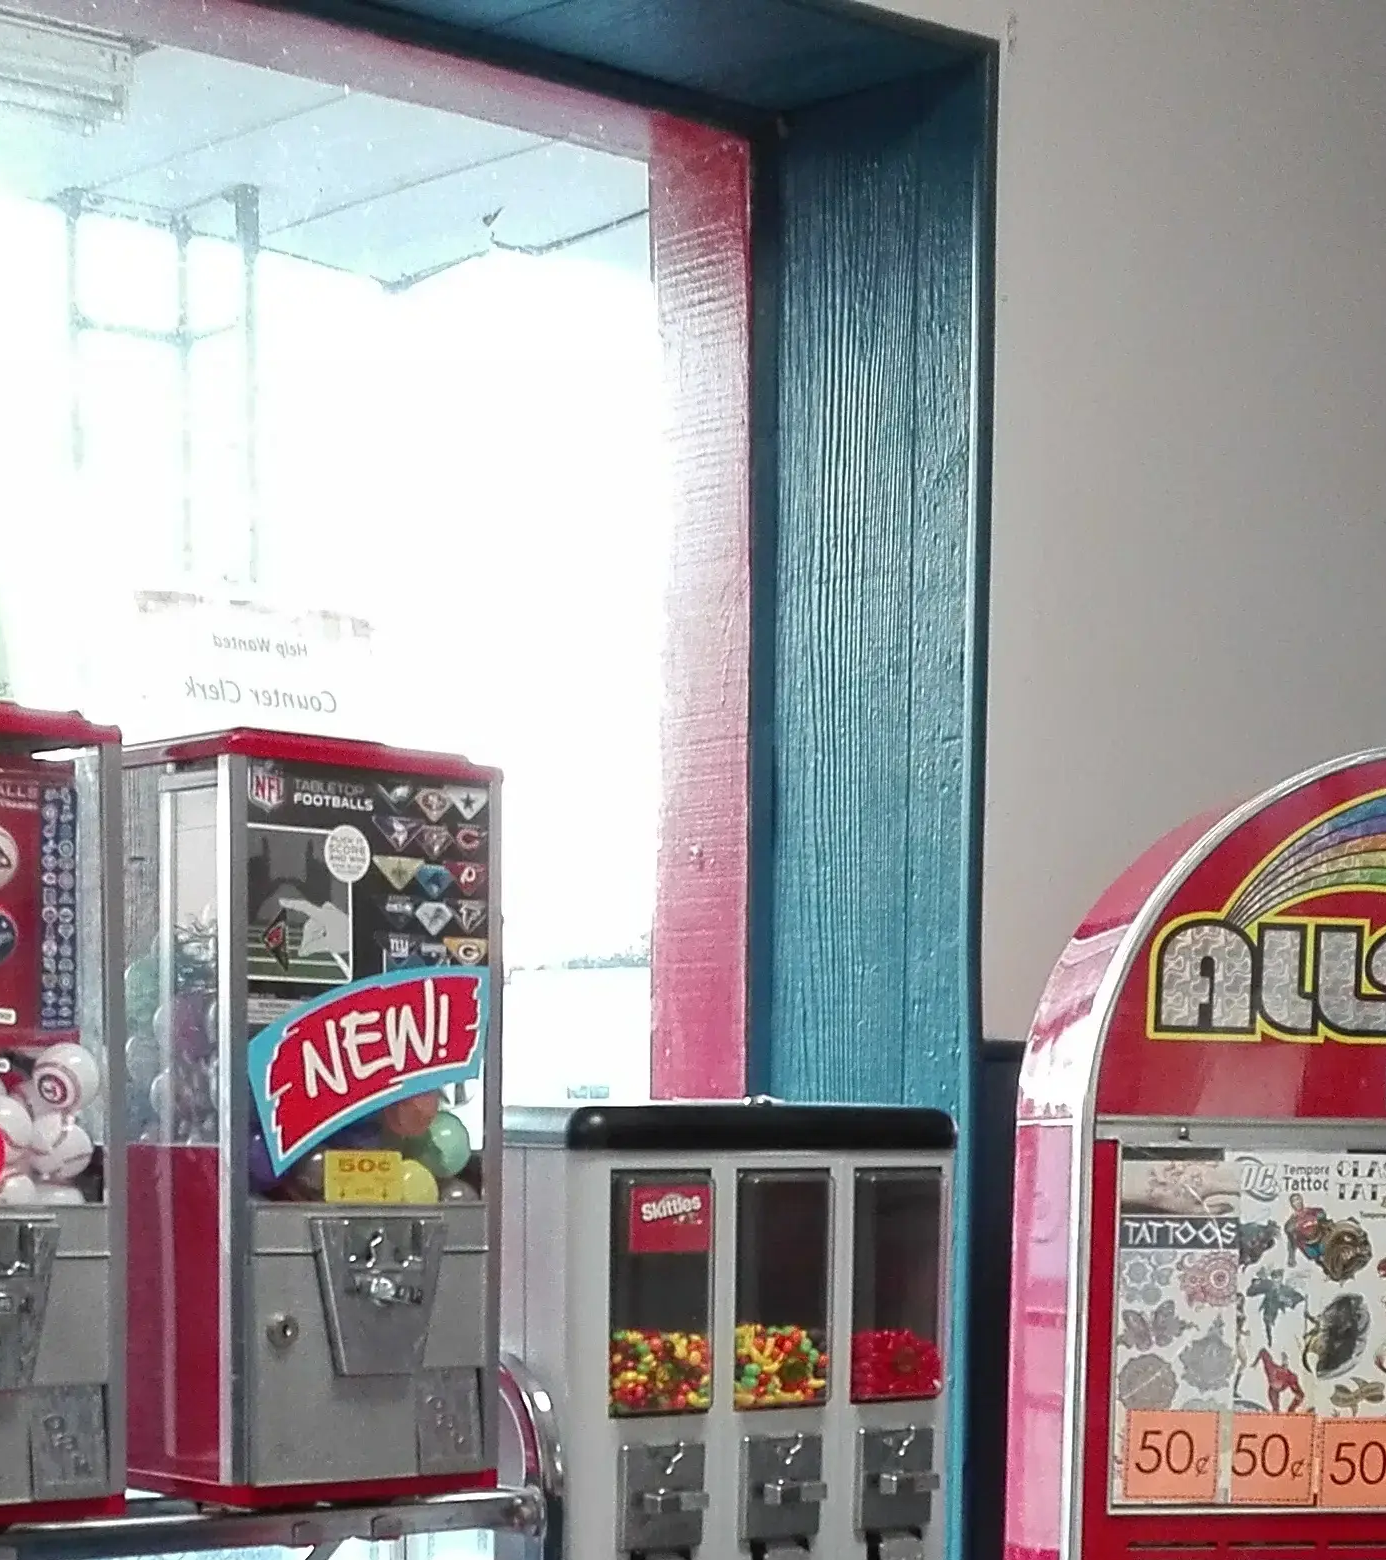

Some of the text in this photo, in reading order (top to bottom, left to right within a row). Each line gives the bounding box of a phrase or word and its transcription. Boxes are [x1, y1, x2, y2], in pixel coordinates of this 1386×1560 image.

[293, 778, 365, 796] TABLETOP
[293, 793, 374, 813] FOOTBALLS
[301, 978, 450, 1099] NEW!
[640, 1195, 702, 1223] Skittles
[1124, 1220, 1237, 1246] TATTOOS
[1134, 1430, 1210, 1477] 50¢
[1231, 1432, 1305, 1480] 50¢
